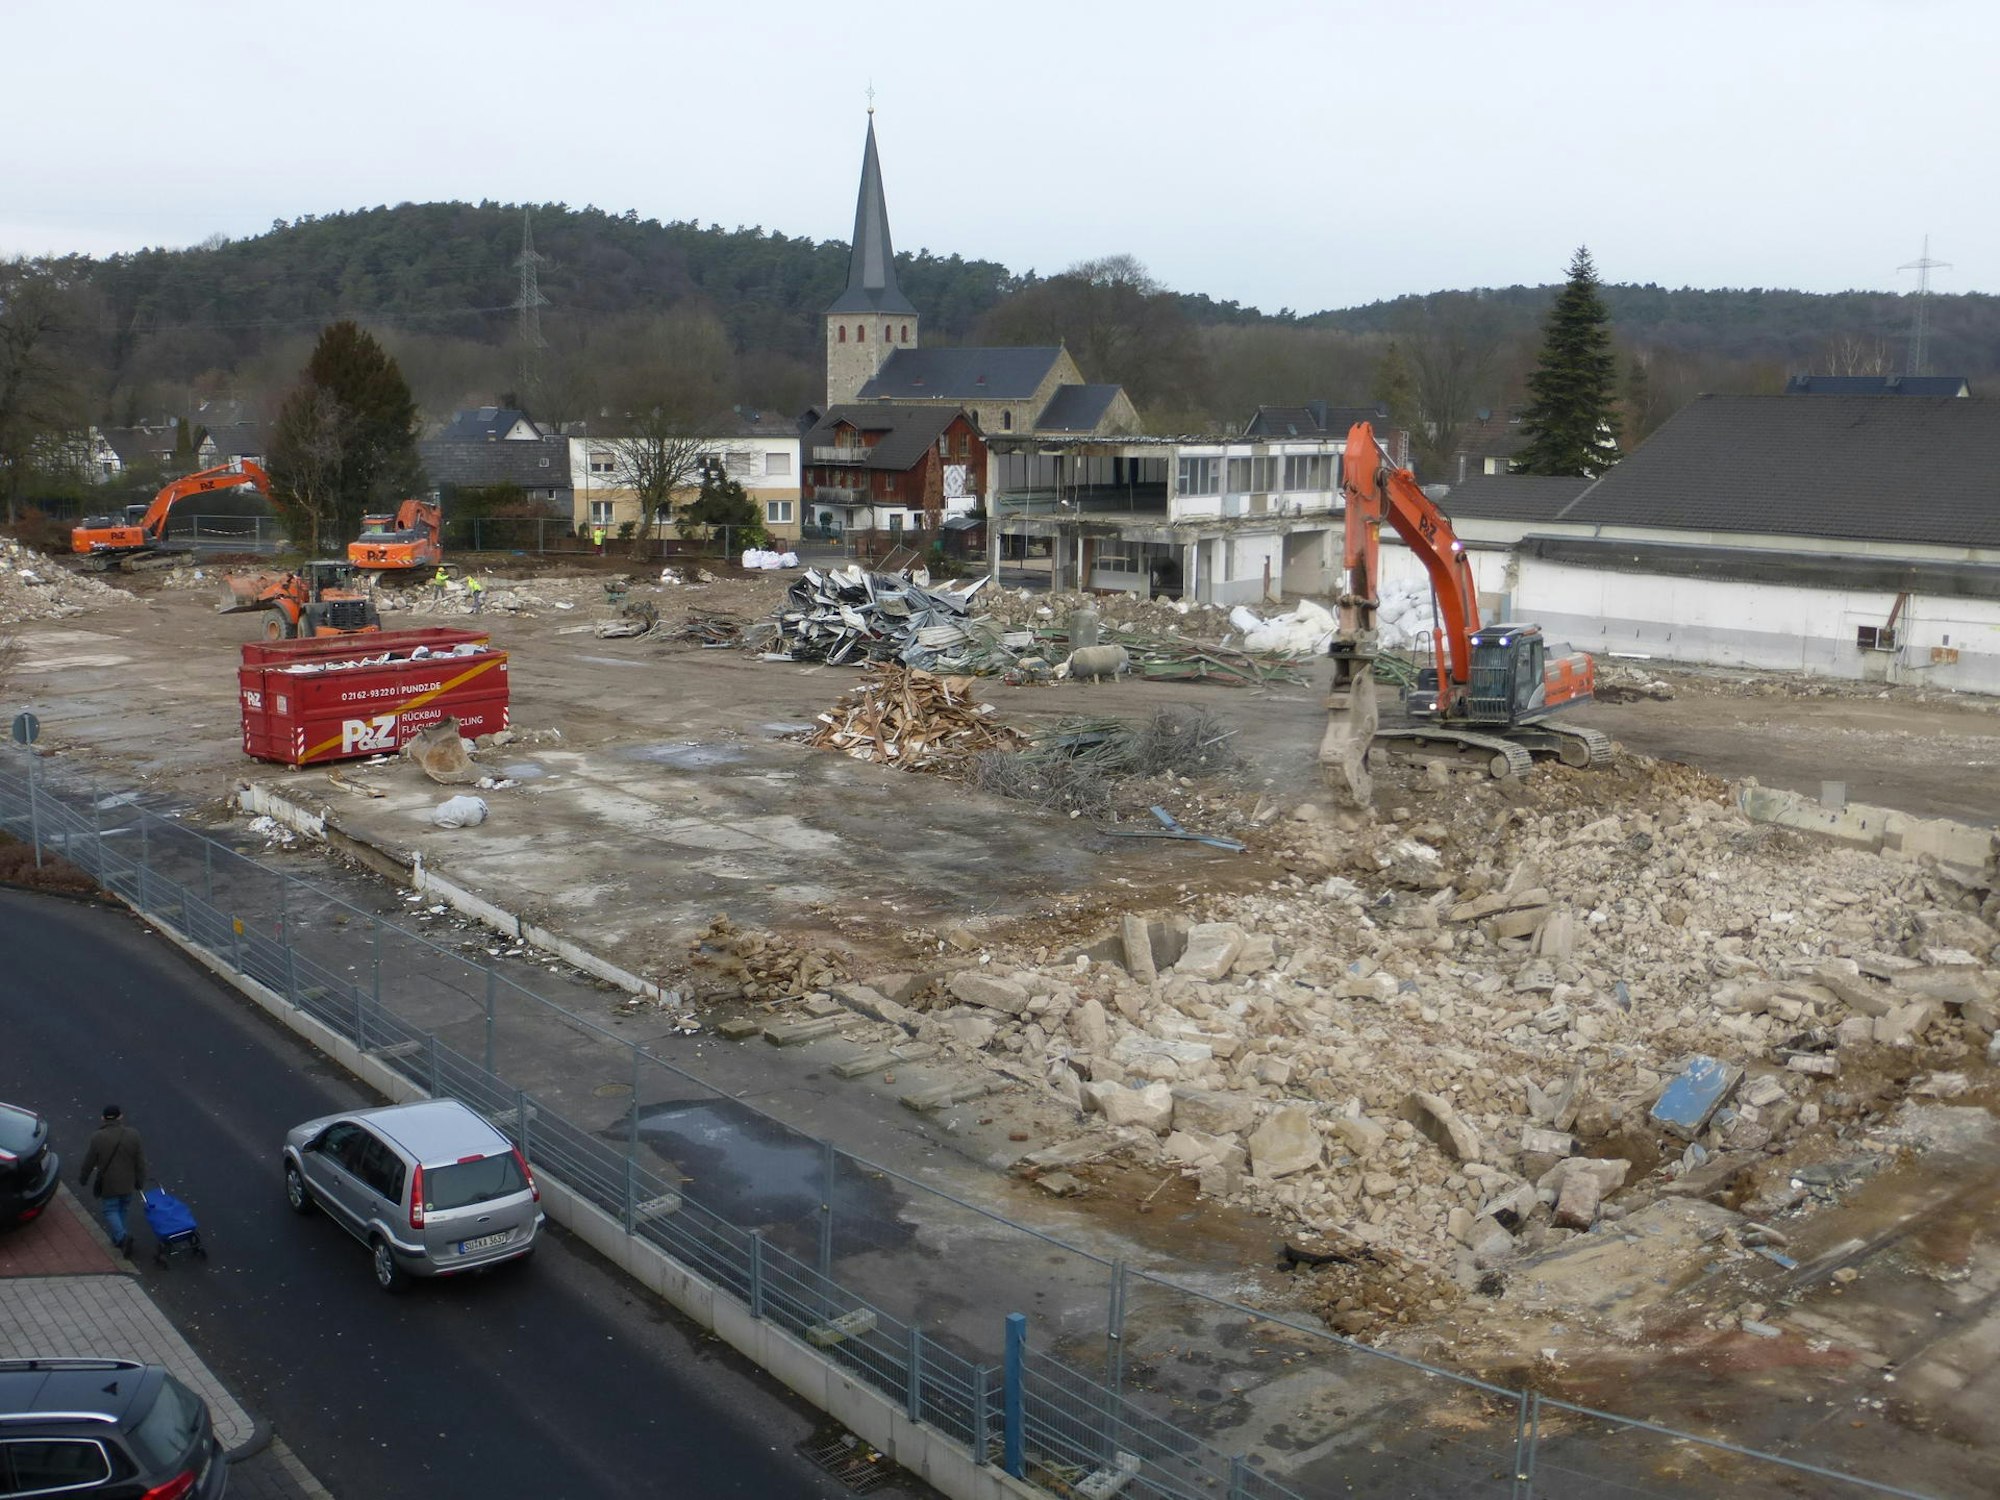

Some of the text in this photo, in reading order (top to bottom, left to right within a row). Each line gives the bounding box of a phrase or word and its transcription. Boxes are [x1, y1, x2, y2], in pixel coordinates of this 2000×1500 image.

[401, 682, 441, 694] PUNDZ.DE
[402, 709, 441, 722] RÜCKBAU
[341, 715, 396, 753] P&Z
